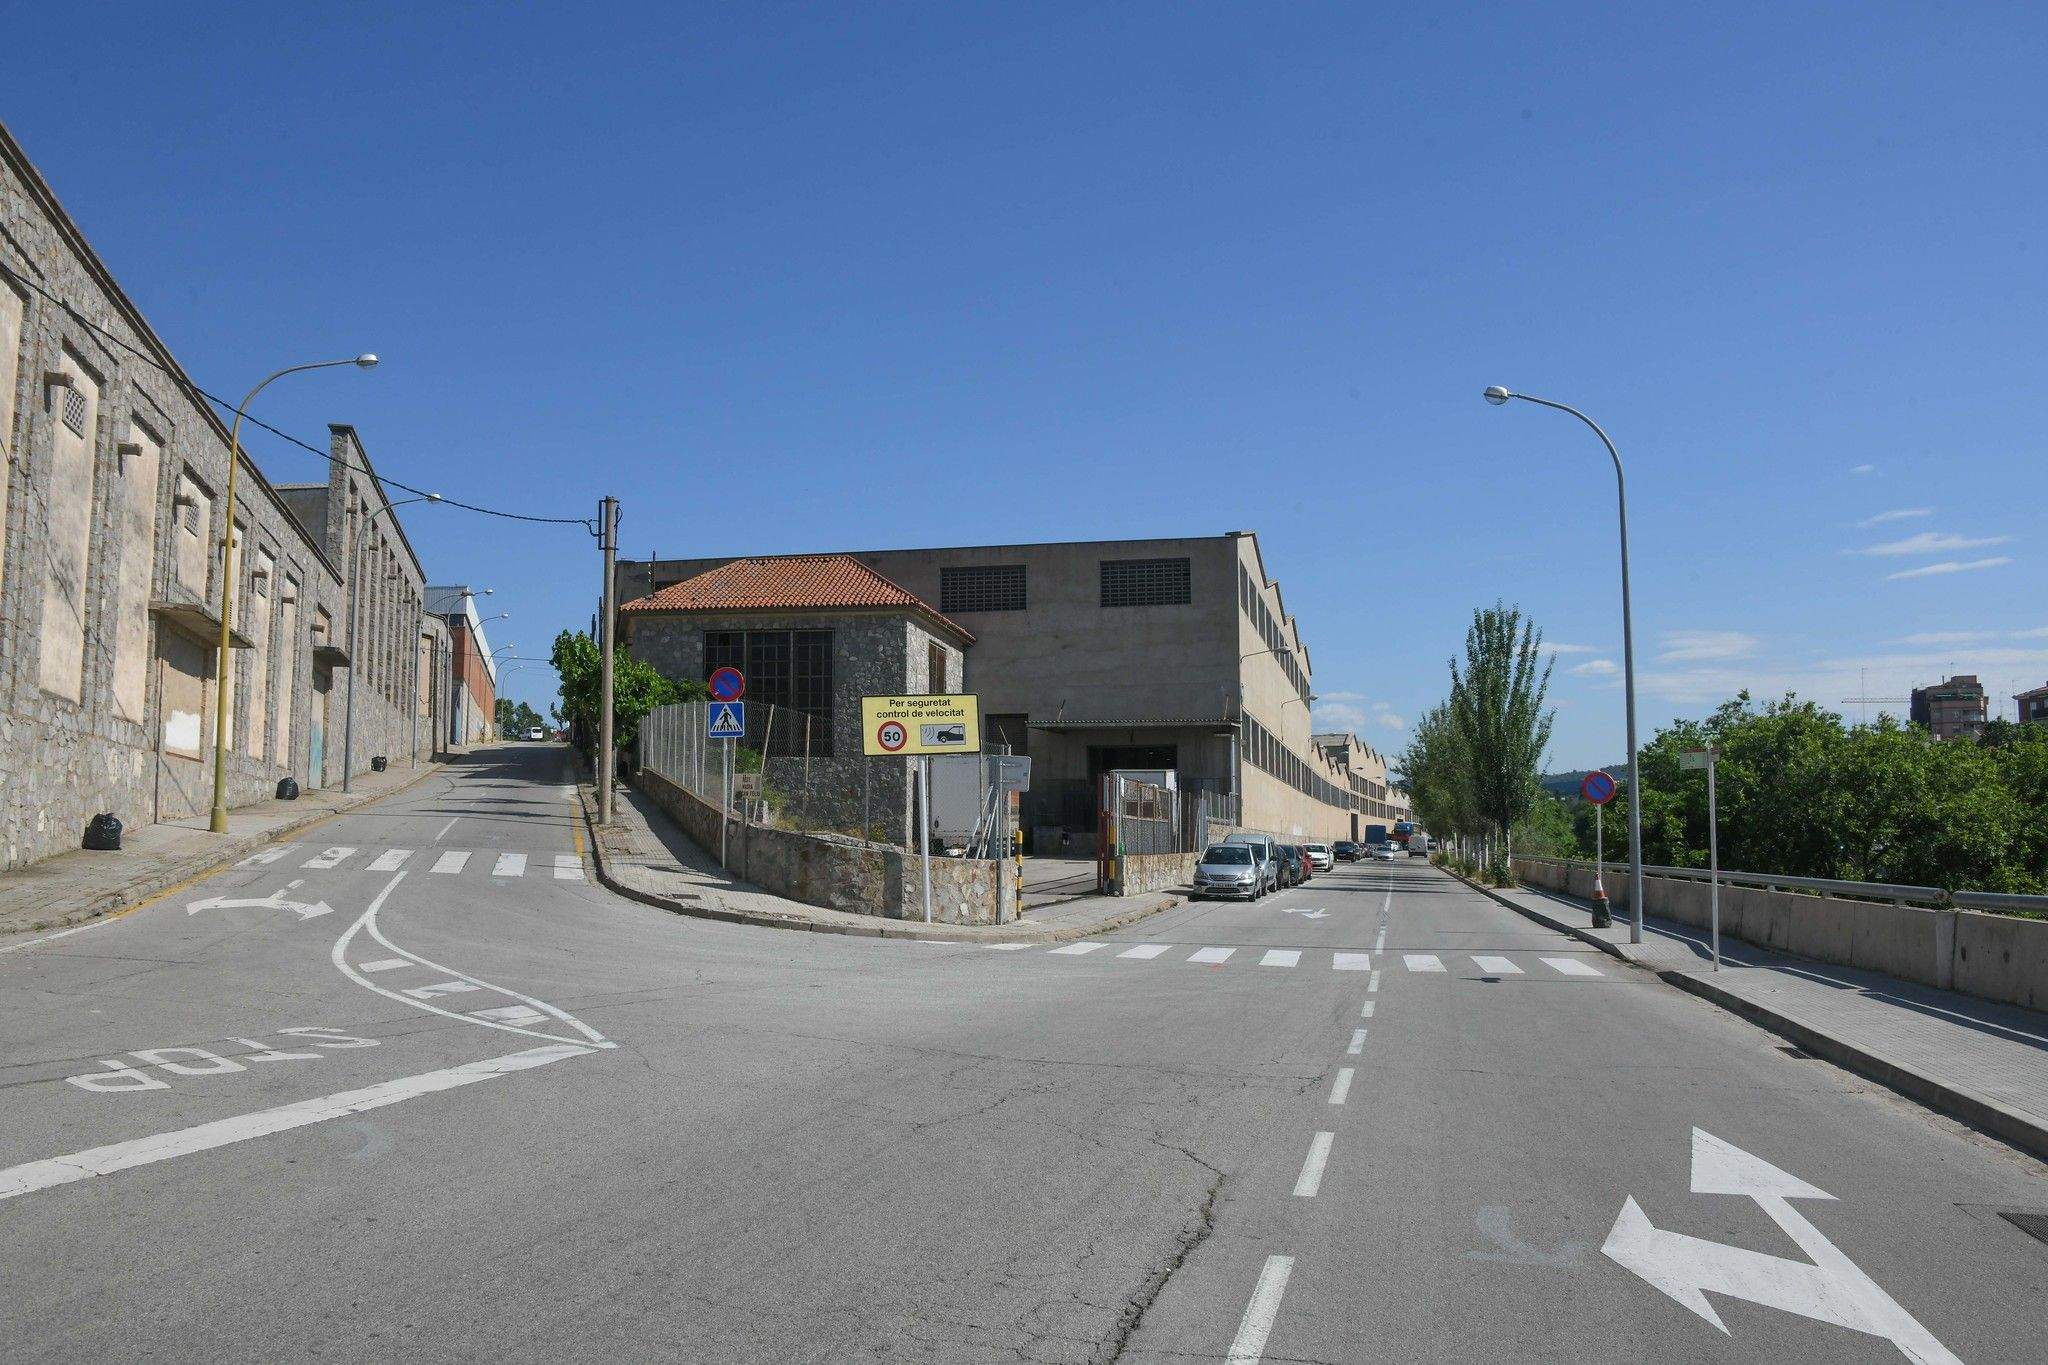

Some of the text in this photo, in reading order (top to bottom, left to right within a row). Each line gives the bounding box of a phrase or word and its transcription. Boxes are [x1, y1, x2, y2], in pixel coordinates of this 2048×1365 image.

[889, 698, 951, 708] Per seguretat
[876, 708, 965, 719] control de velocitat
[883, 731, 901, 742] 50
[65, 1027, 382, 1093] STOP
